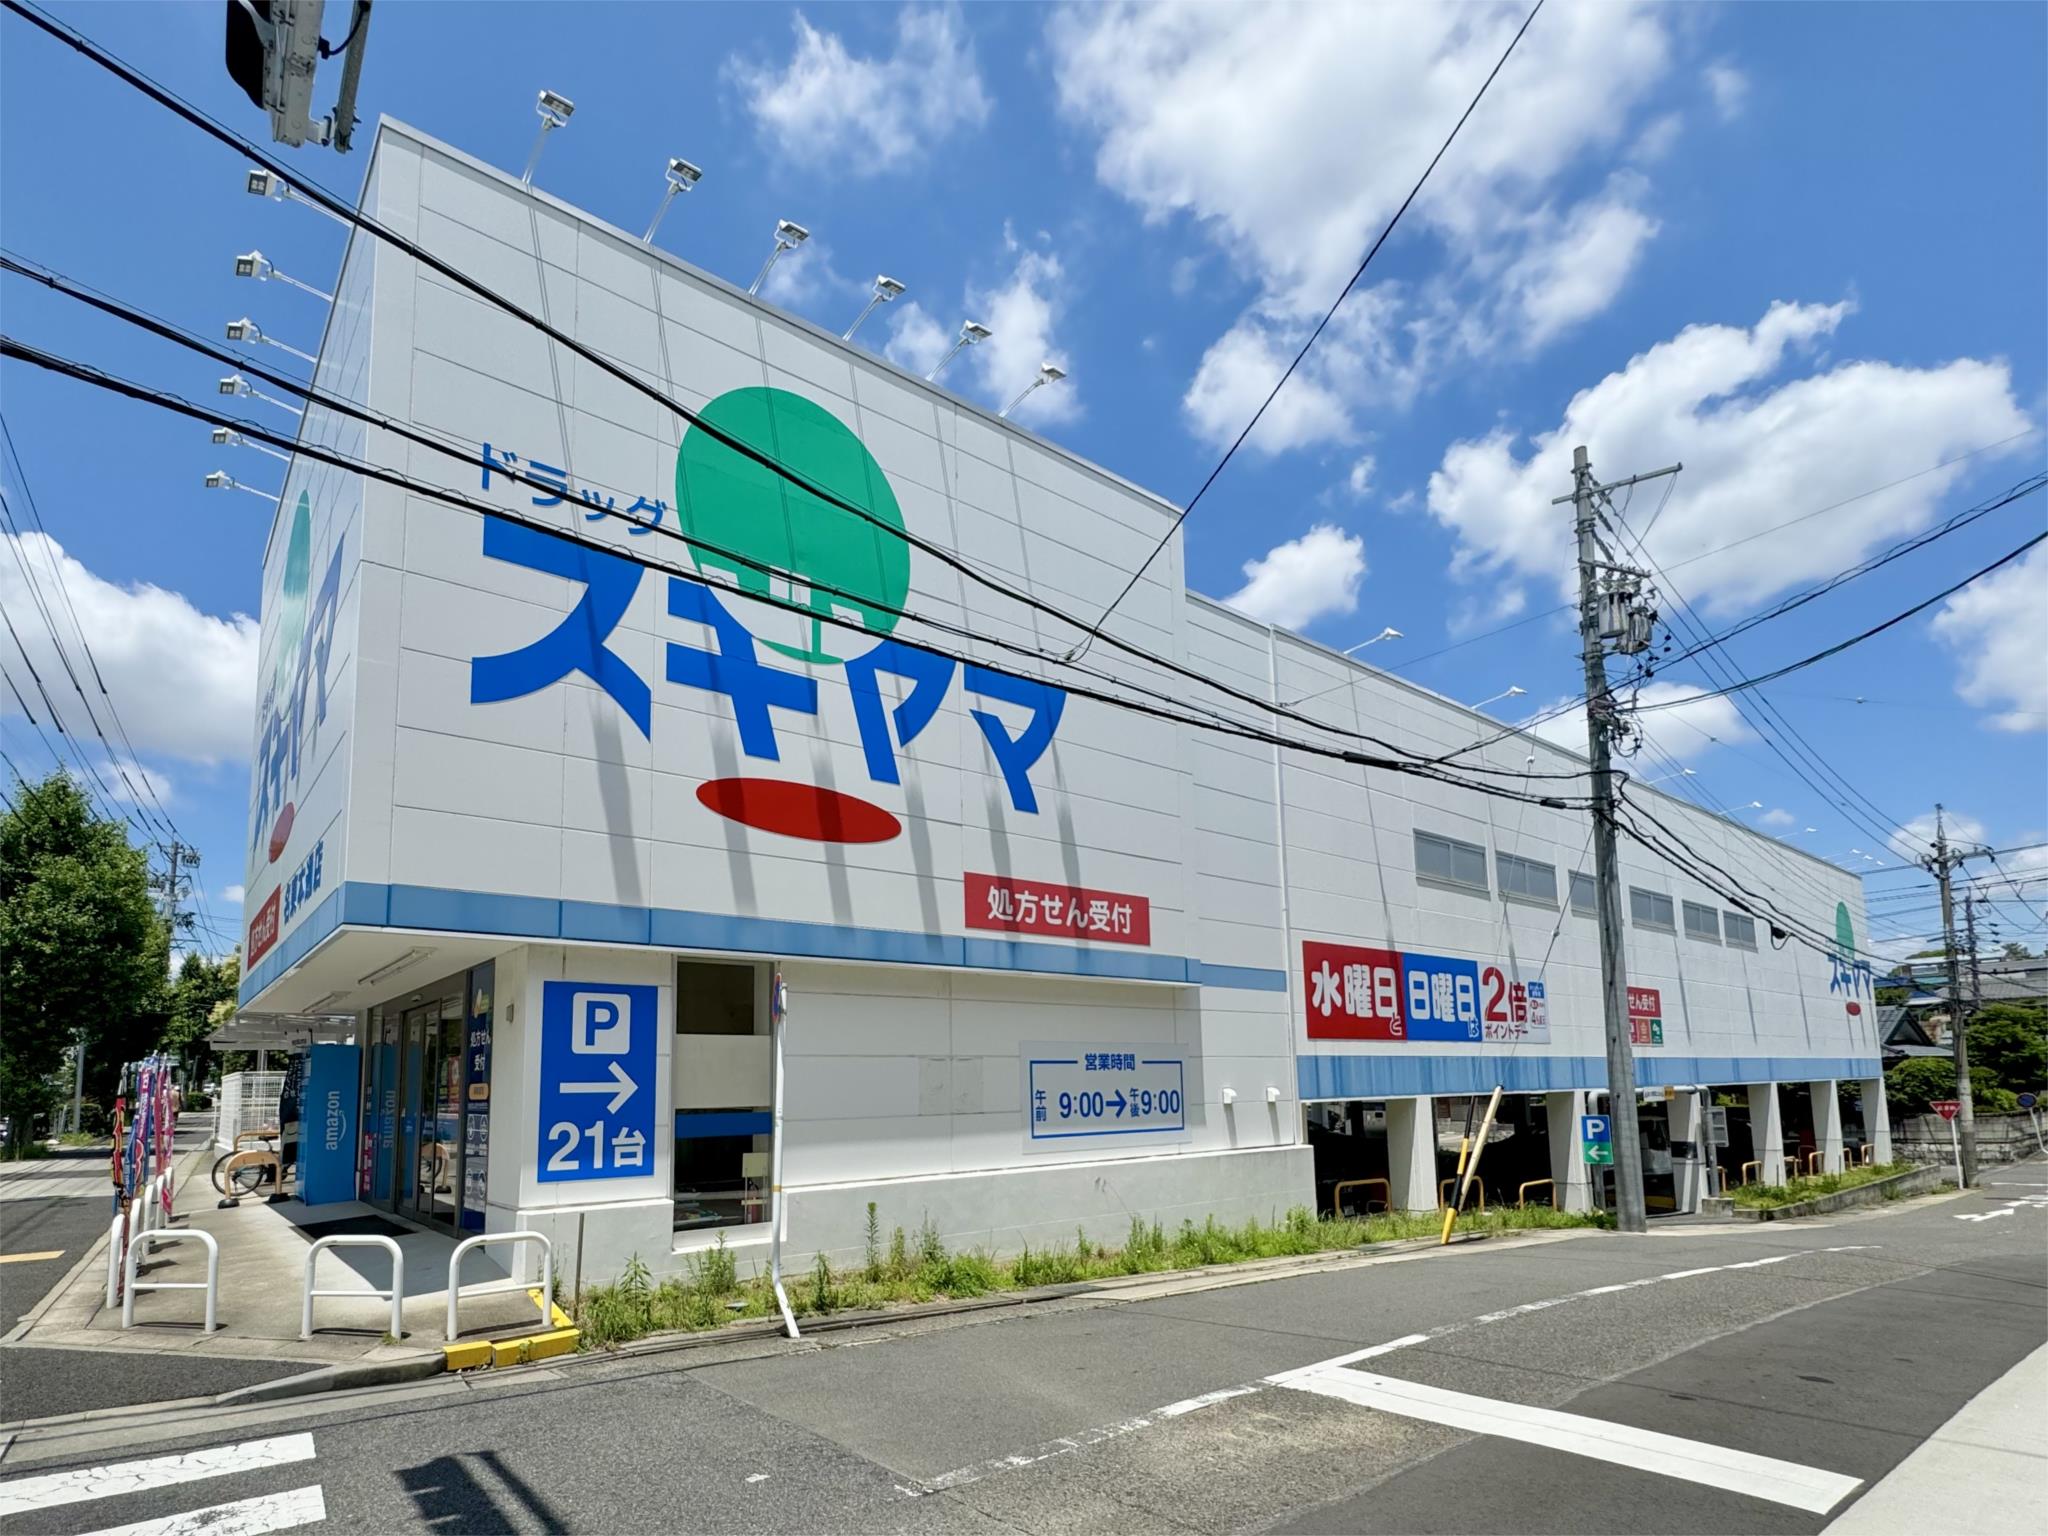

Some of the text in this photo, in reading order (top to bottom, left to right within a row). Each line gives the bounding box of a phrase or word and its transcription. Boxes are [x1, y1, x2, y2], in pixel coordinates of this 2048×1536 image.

[481, 442, 667, 536] ドラッグ
[987, 886, 1133, 934] 処方せん受付
[585, 1000, 620, 1047] P
[1485, 1024, 1529, 1041] ポイントデー
[1084, 1053, 1136, 1072] 営業時間
[1034, 1089, 1047, 1122] 午前
[1059, 1091, 1104, 1118] 9:00
[1129, 1087, 1141, 1118] 午後
[1140, 1089, 1181, 1115] 9:00
[325, 1090, 342, 1151] amazon
[1586, 1118, 1606, 1140] P
[546, 1120, 646, 1172] 21台
